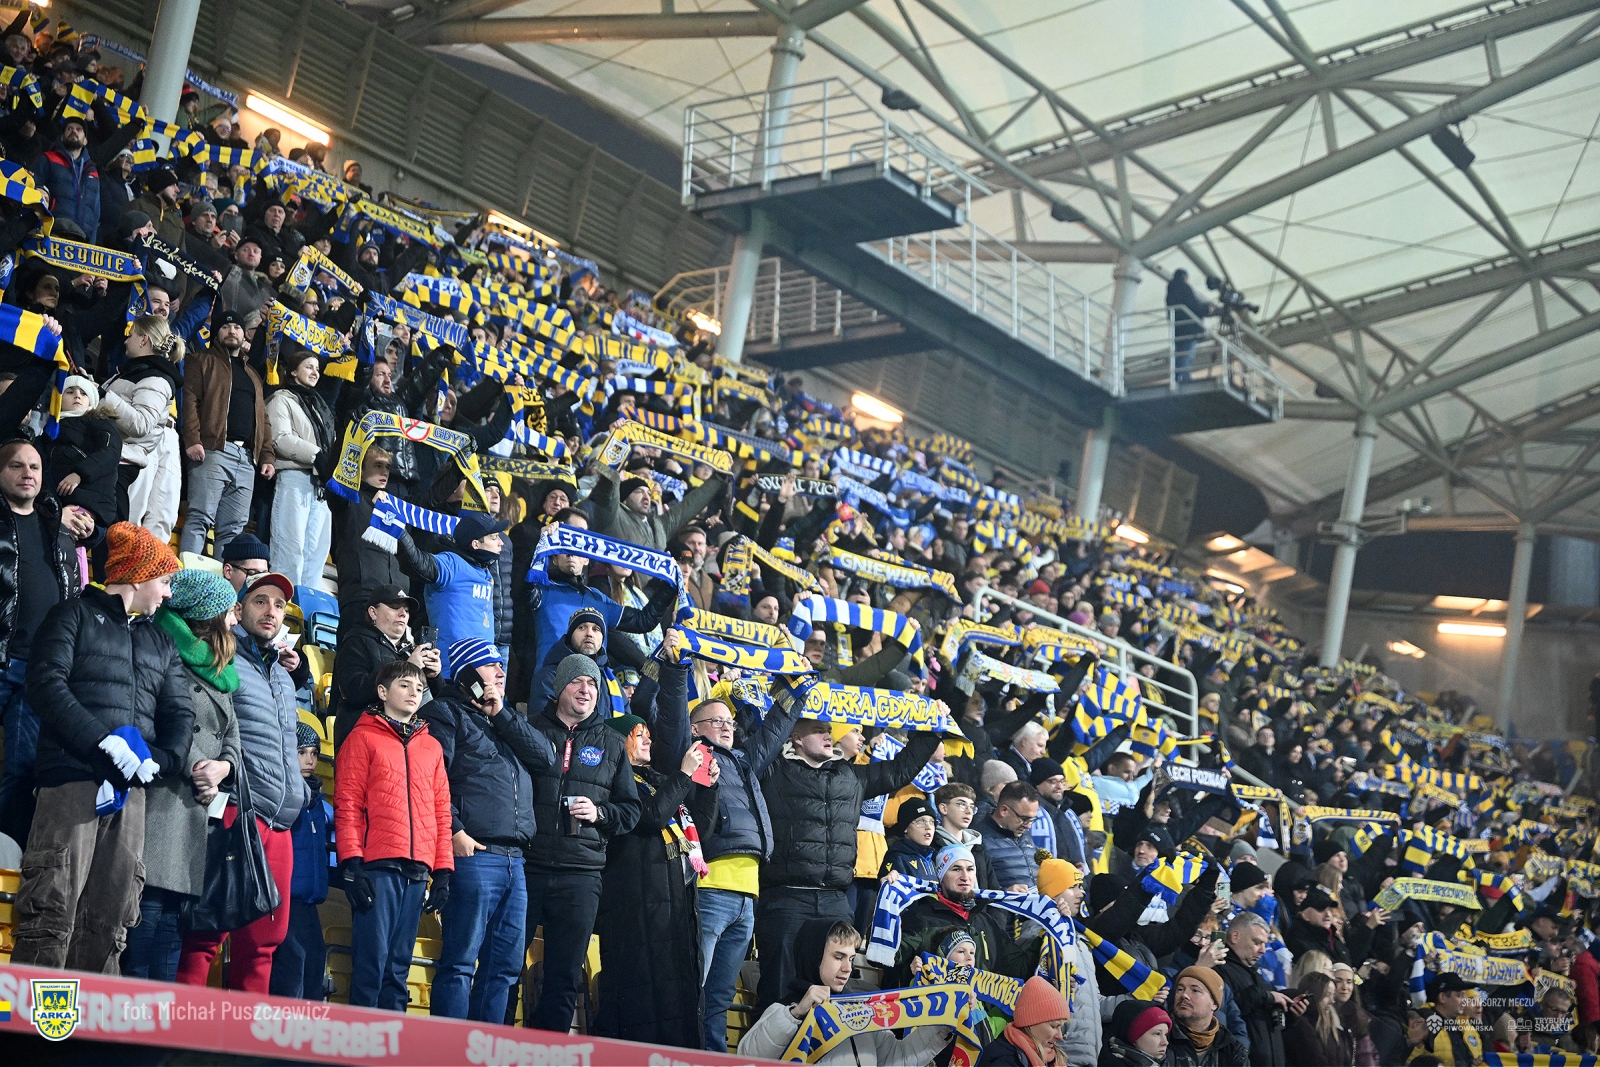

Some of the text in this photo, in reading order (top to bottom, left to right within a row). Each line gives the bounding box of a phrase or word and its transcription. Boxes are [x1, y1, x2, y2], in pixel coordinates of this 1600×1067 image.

[427, 279, 463, 297] LEC
[547, 530, 599, 554] LECH
[828, 690, 874, 719] ARKA
[877, 695, 938, 726] GDYNIA
[1166, 765, 1191, 782] LECH
[0, 972, 176, 1033] SUERBET
[970, 968, 1023, 1012] WIKINGO
[844, 1010, 869, 1020] ARKA
[250, 1002, 404, 1059] SUPERBET
